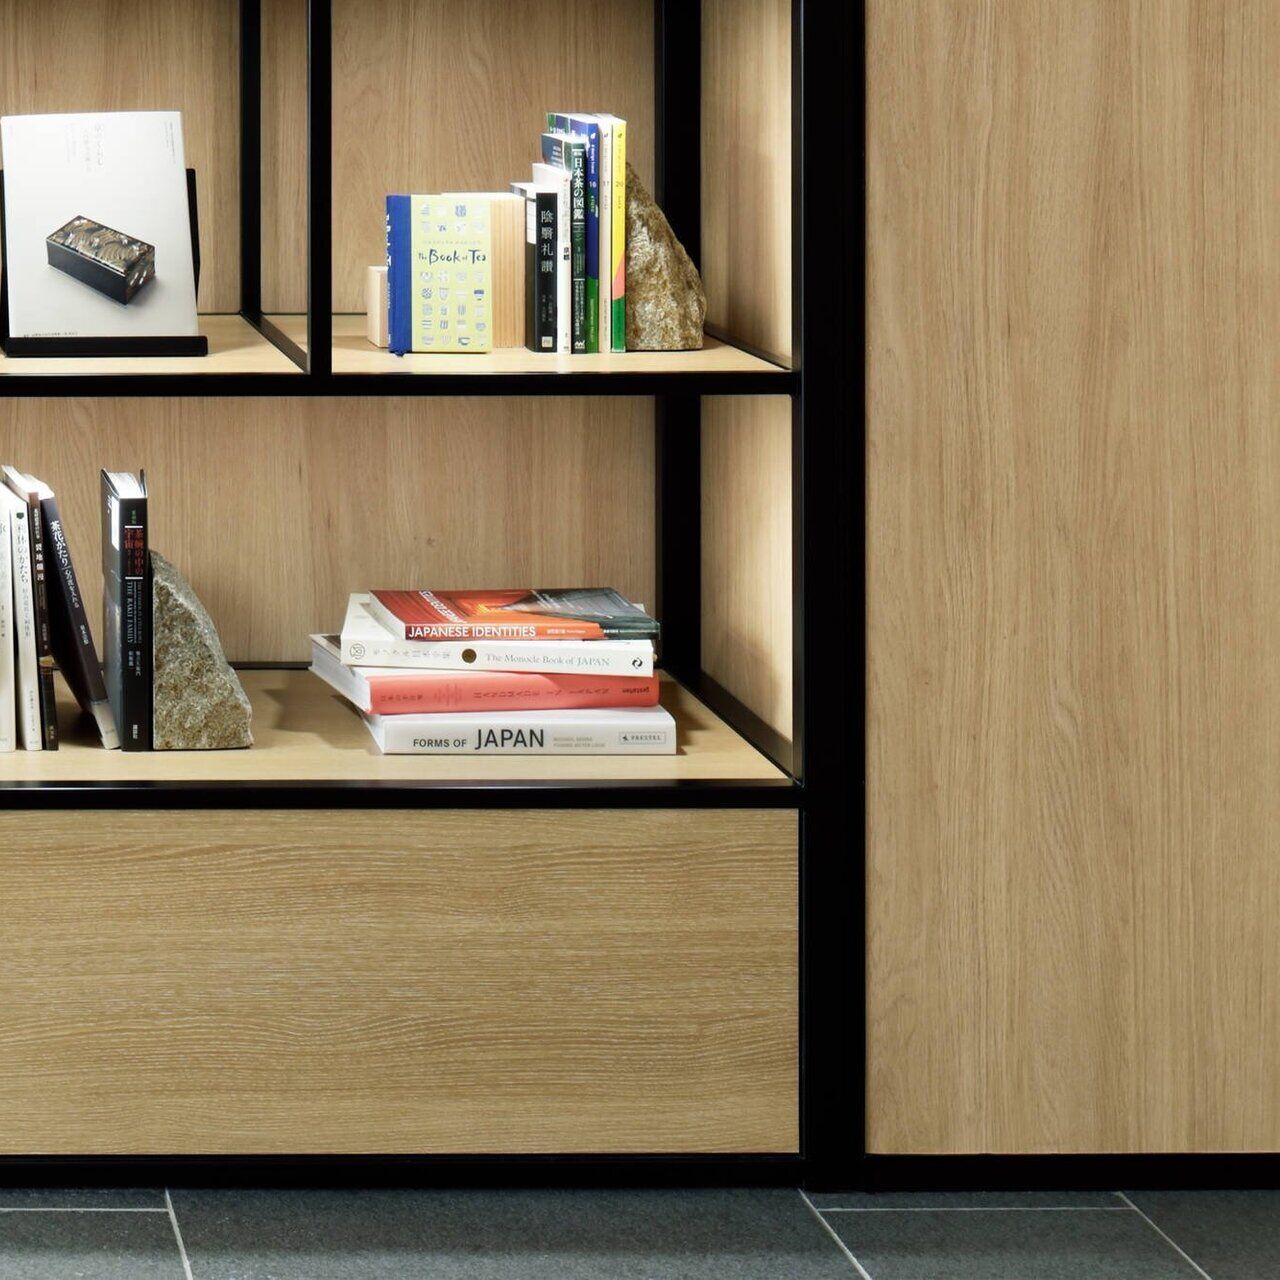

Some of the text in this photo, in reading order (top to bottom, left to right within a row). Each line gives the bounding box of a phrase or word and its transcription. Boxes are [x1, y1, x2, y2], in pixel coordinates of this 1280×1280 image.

[573, 157, 585, 220] 日本茶の図鑑
[428, 248, 460, 265] Book
[468, 249, 487, 264] Tea
[50, 520, 69, 567] 茶花がたり
[408, 626, 536, 639] JAPANESE IDENTITIES
[486, 653, 610, 668] The Monocle Book of JAPAN
[622, 686, 650, 694] gestalten
[413, 728, 544, 751] FORMS OF JAPAN
